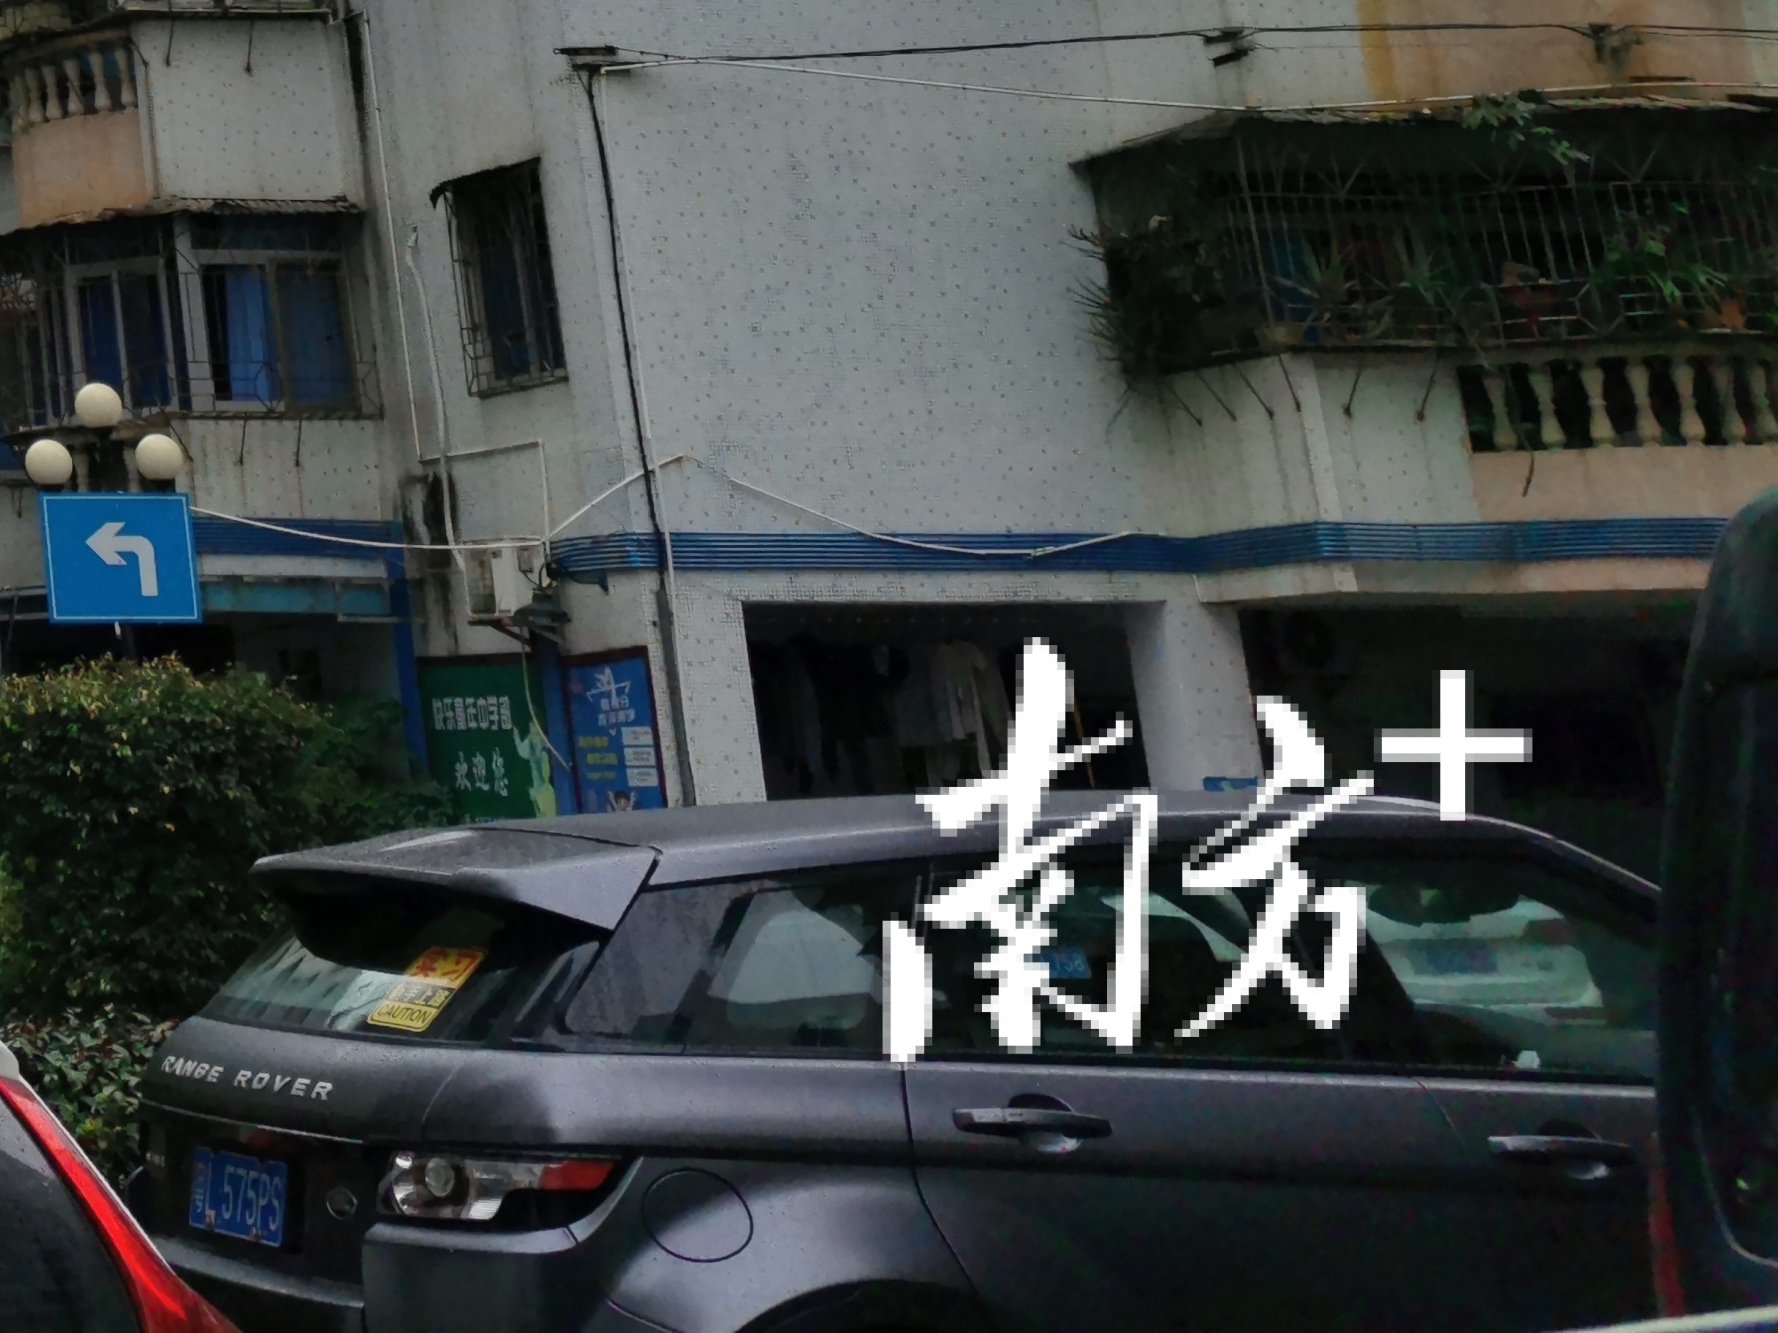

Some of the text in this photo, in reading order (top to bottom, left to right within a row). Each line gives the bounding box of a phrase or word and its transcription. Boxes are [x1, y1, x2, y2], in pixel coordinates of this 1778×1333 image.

[453, 746, 509, 797] 欢迎您
[376, 1002, 432, 1024] CAUTION
[161, 1055, 333, 1101] RANGE ROVER
